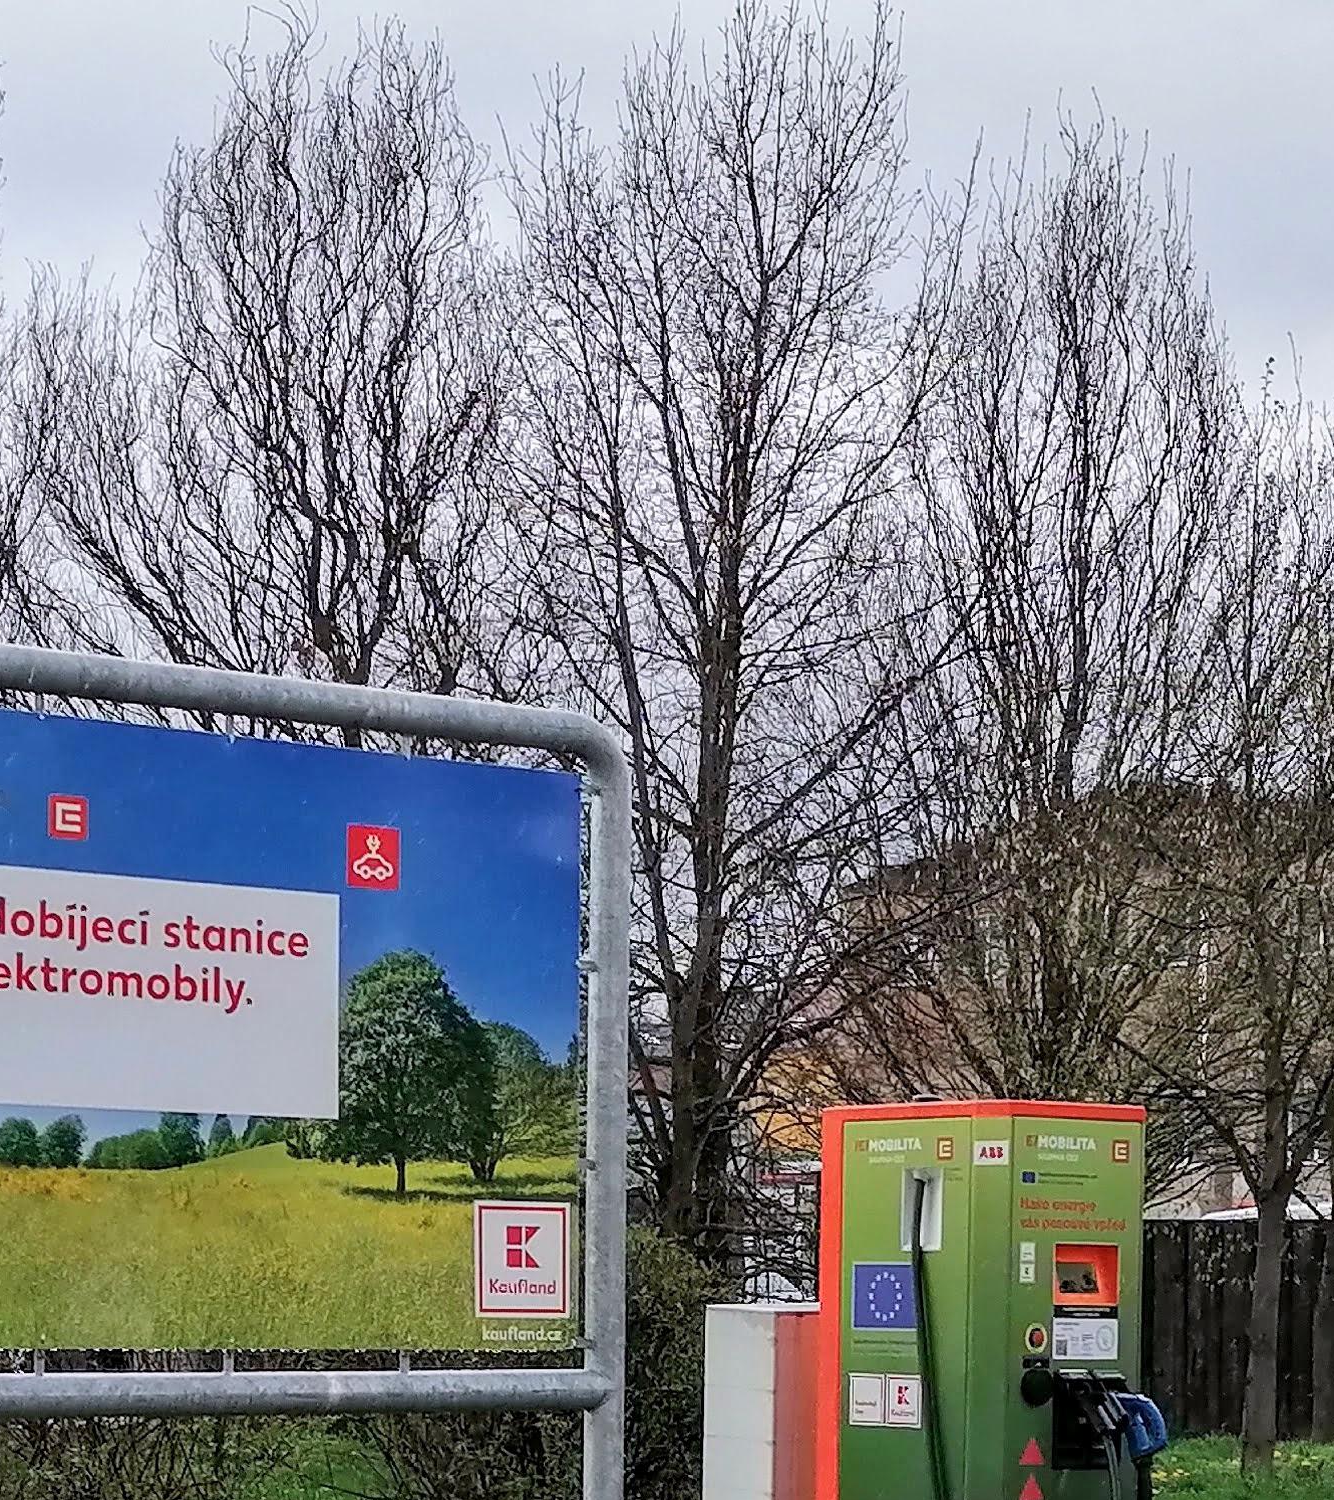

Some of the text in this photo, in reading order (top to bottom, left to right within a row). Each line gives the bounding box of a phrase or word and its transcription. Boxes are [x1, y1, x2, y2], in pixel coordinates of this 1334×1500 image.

[163, 916, 310, 959] stanice
[489, 1278, 557, 1295] Kaufland
[481, 1325, 563, 1341] kaufland.cz
